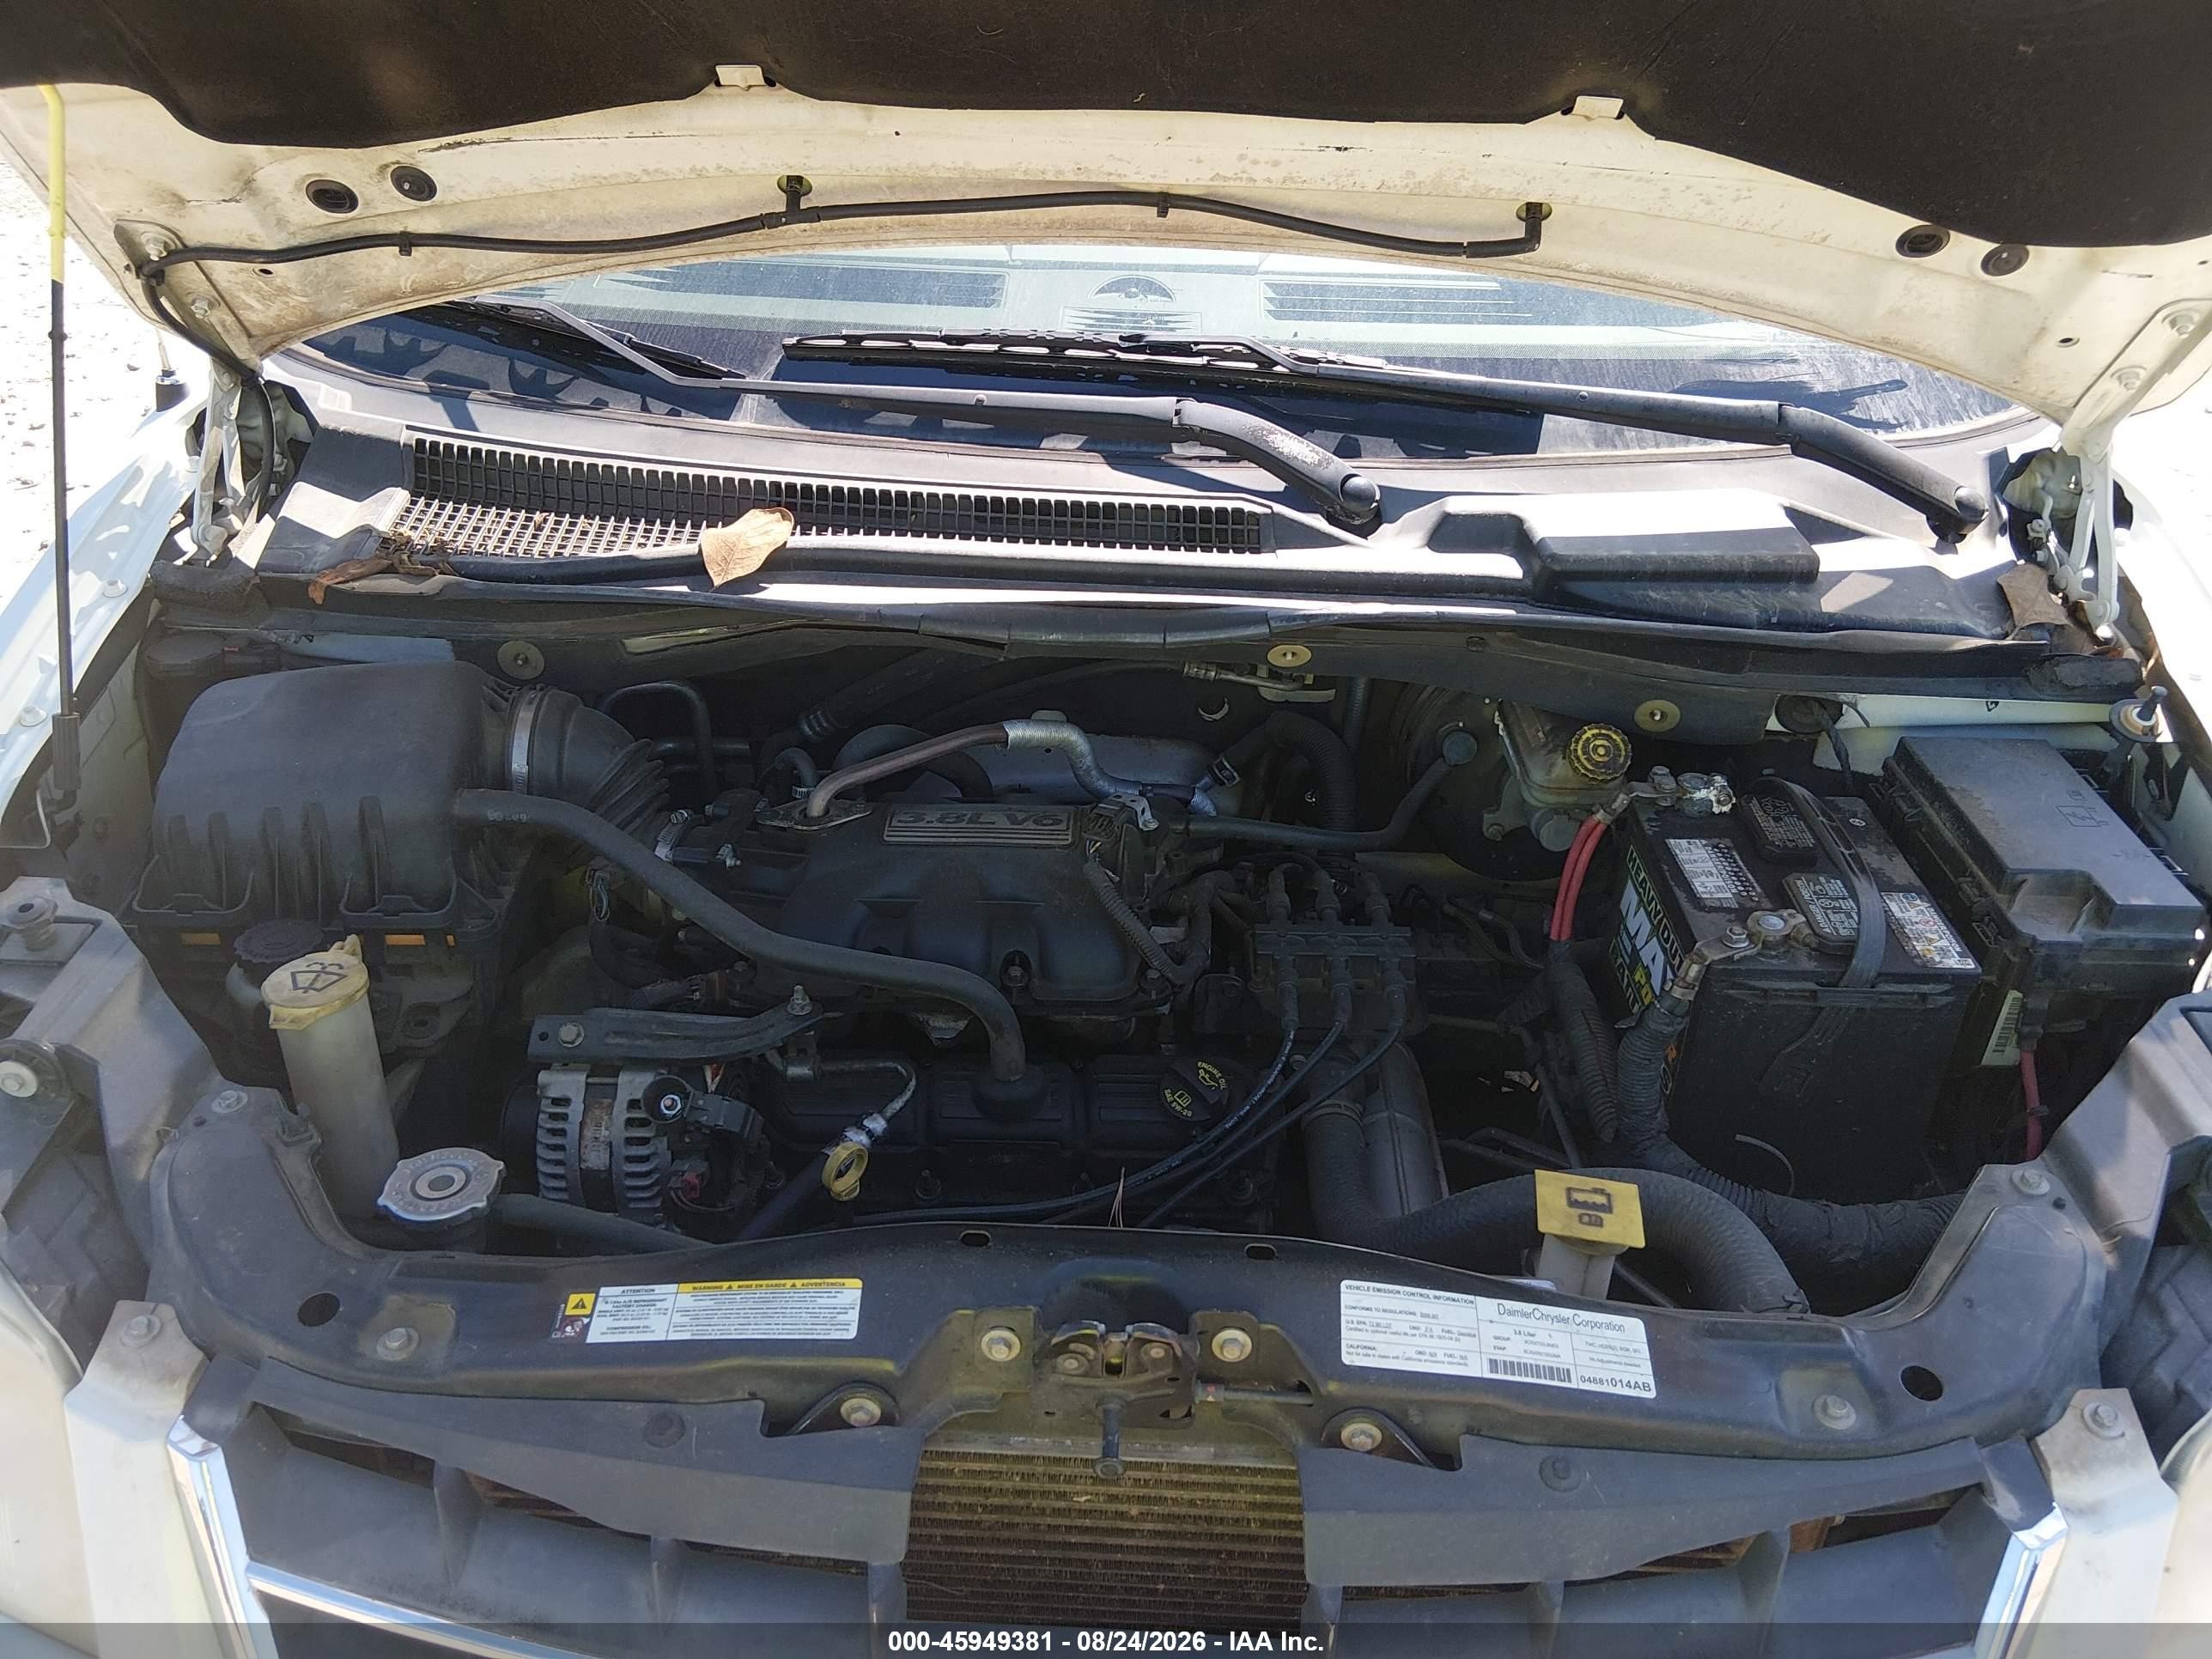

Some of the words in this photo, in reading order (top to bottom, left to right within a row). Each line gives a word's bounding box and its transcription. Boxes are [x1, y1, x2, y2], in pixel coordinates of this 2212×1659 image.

[896, 811, 996, 826] 3.8L
[1004, 812, 1064, 827] V6
[1626, 844, 1664, 924] HEAVY
[1197, 1061, 1222, 1079] ENGINE
[1218, 1078, 1228, 1091] OIL
[1164, 1089, 1175, 1103] SAE
[1170, 1101, 1193, 1117] 5W-20
[1372, 1287, 1401, 1296] EMISSION
[1402, 1291, 1431, 1300] CONTROL
[1433, 1295, 1474, 1305] INFORMATION
[1497, 1303, 1571, 1325] DaimlerChrysler
[1572, 1314, 1626, 1333] Corporation
[1580, 1375, 1651, 1392] 04881014AB
